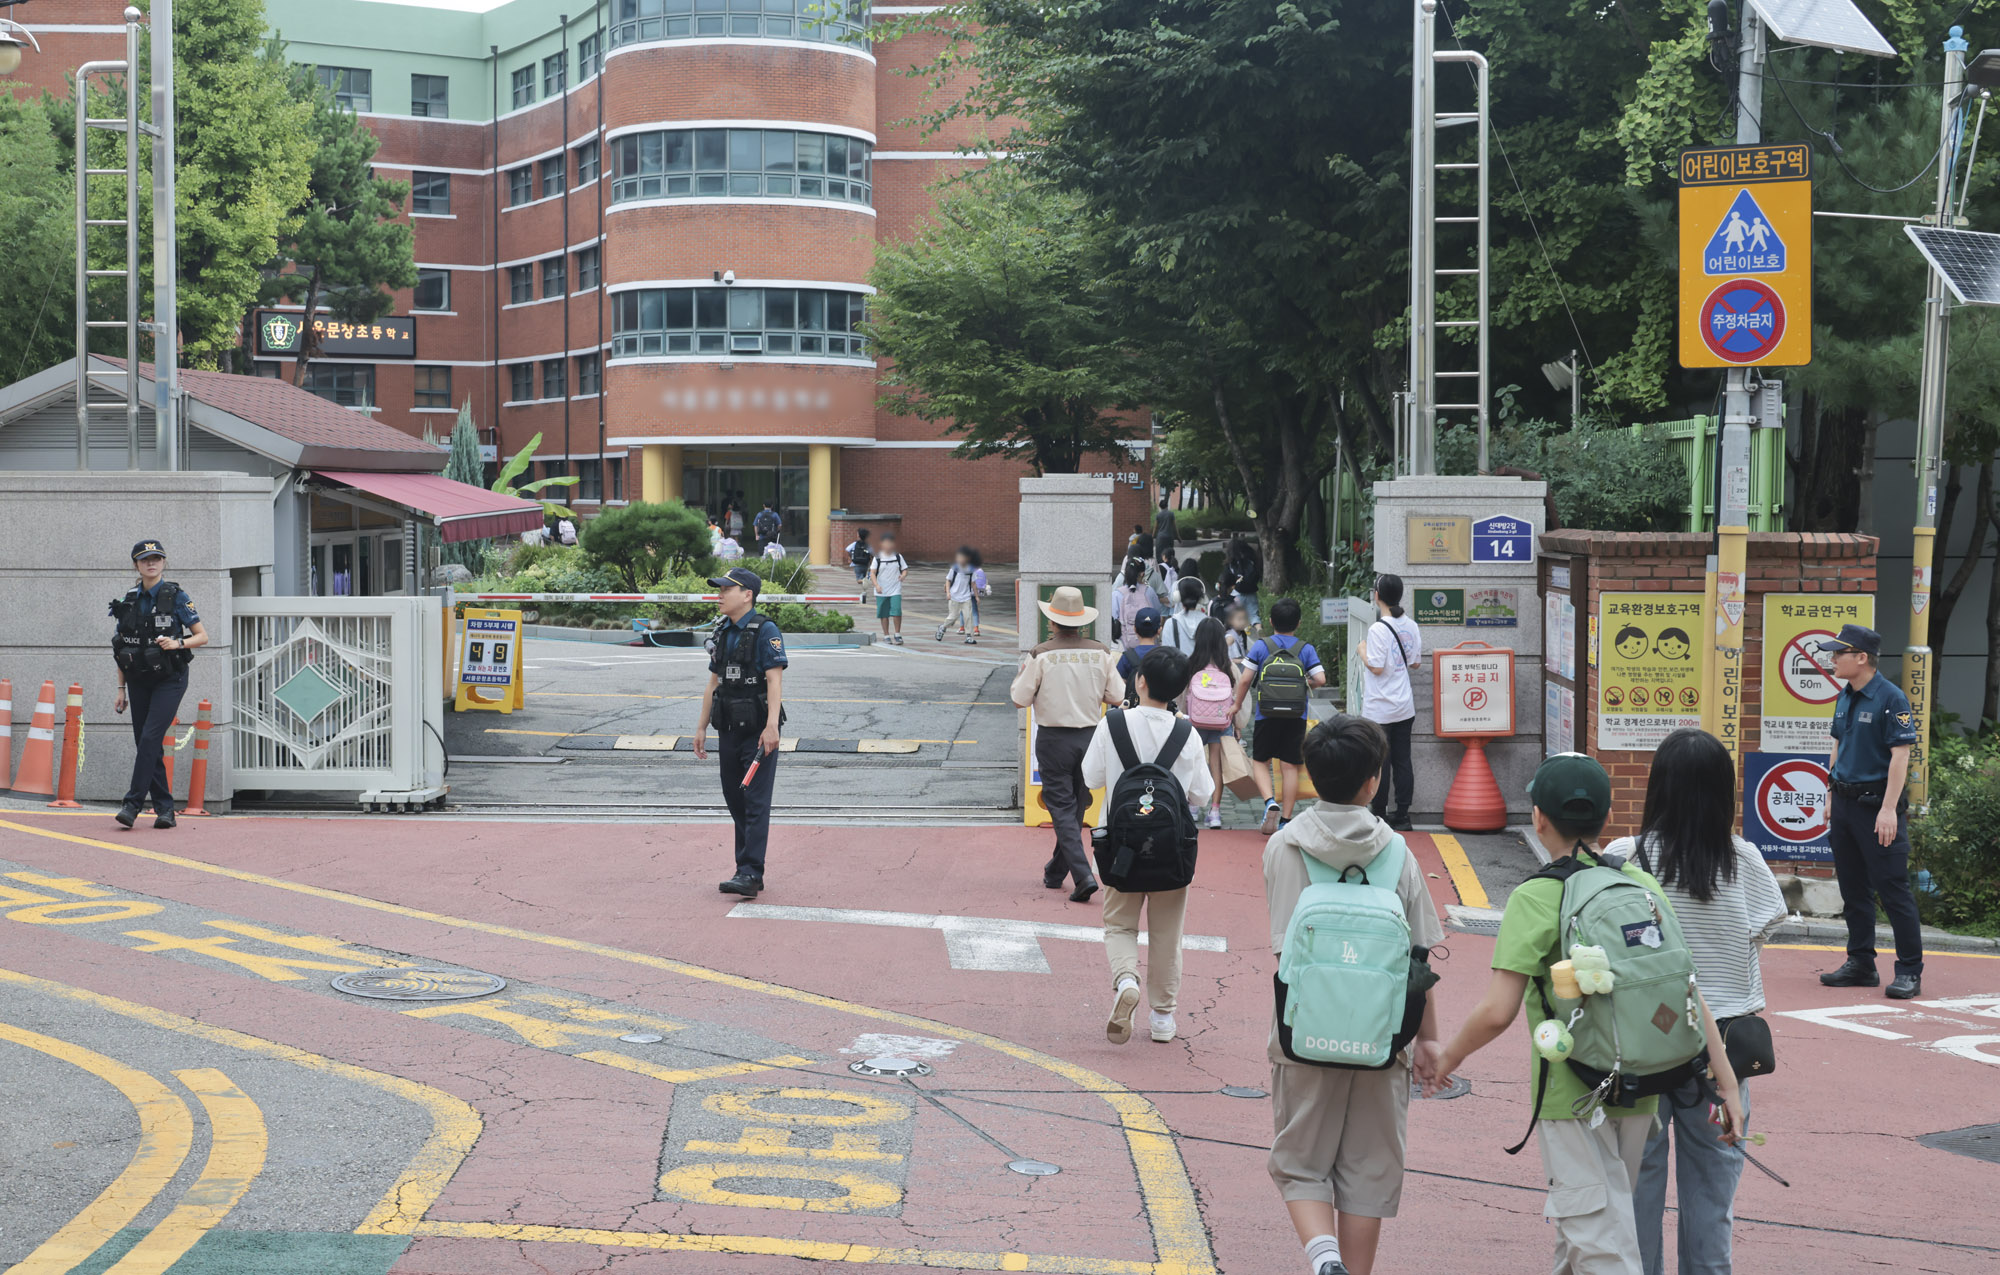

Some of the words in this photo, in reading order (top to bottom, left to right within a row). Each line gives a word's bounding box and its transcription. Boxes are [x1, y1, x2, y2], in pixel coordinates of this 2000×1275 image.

[1685, 149, 1804, 179] 어린이보호구역
[1708, 253, 1781, 271] 어린이보호
[1713, 312, 1773, 330] 주정차금지
[1488, 522, 1517, 530] 신대방2길
[1489, 539, 1515, 557] 14
[1608, 603, 1700, 616] 교육환경보호구역
[1781, 604, 1857, 618] 학교금연구역
[472, 645, 481, 658] 4
[495, 645, 505, 660] 9
[1452, 663, 1463, 671] 협조
[1464, 663, 1498, 671] 부탁드립니다
[1800, 680, 1822, 689] 50m
[1605, 718, 1621, 726] 학교
[1623, 718, 1676, 726] 경계선으로부터
[1763, 720, 1777, 729] 학교
[1778, 720, 1785, 729] 내
[1786, 721, 1793, 729] 및
[1794, 721, 1808, 729] 학교
[1771, 791, 1826, 807] 공회전금지
[1799, 845, 1822, 854] 경고없이
[1341, 941, 1358, 964] LA
[1305, 1035, 1378, 1056] DODGERS
